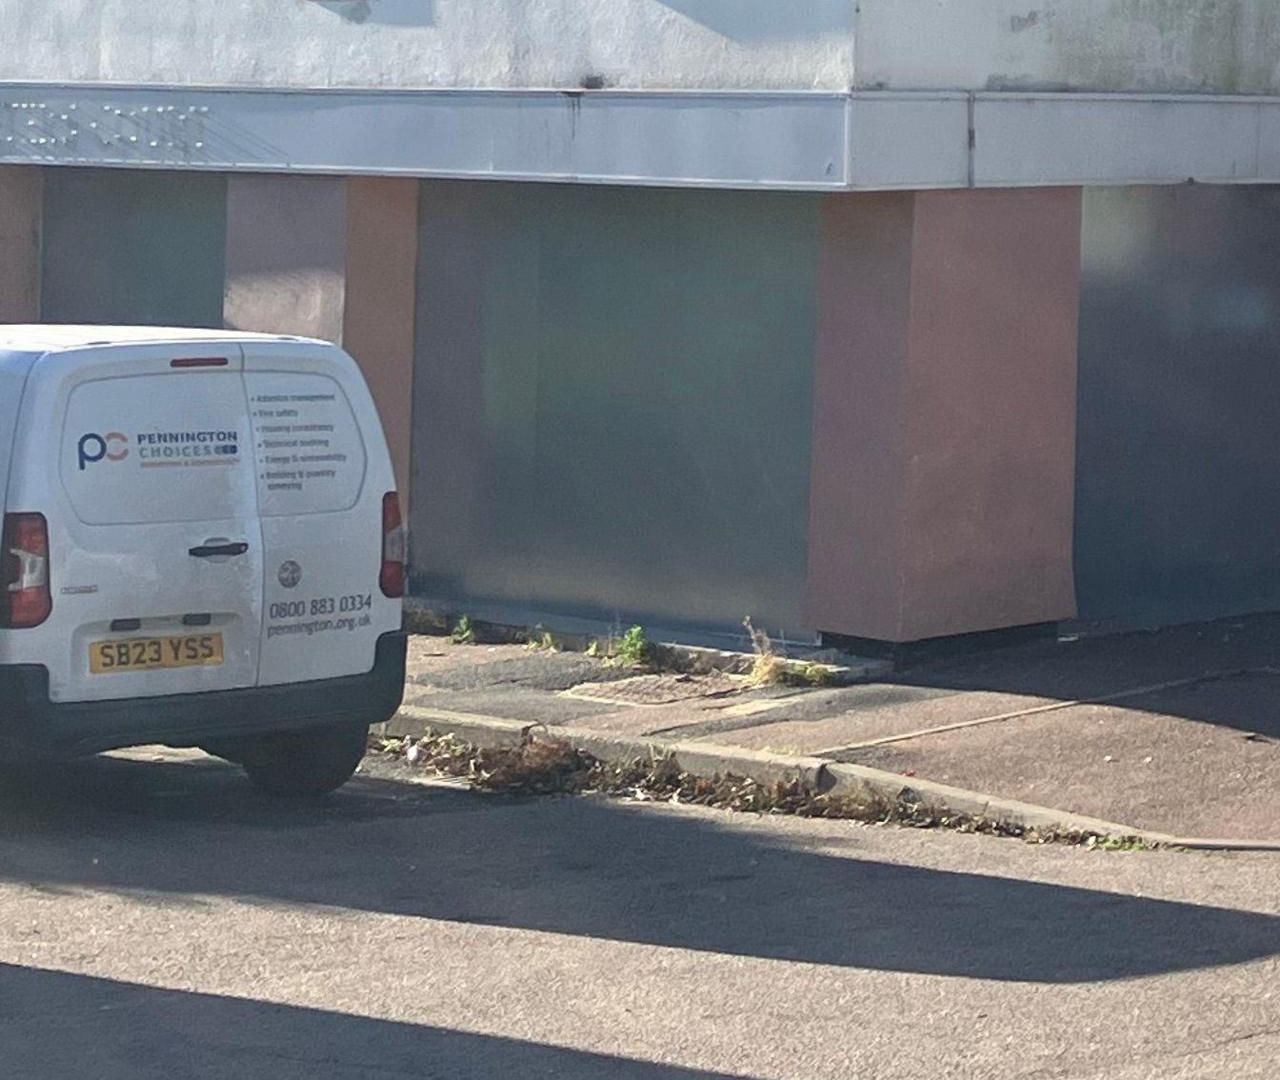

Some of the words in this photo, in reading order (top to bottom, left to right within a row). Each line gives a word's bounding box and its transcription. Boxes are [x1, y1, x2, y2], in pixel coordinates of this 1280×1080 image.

[137, 431, 238, 444] PENNINGTON
[139, 446, 212, 459] CHOICES
[269, 601, 306, 619] 0800
[310, 598, 335, 616] 883
[339, 593, 372, 612] 0334
[267, 614, 372, 639] pennington.org.uk
[100, 640, 163, 668] SB23
[169, 636, 214, 661] YSS
